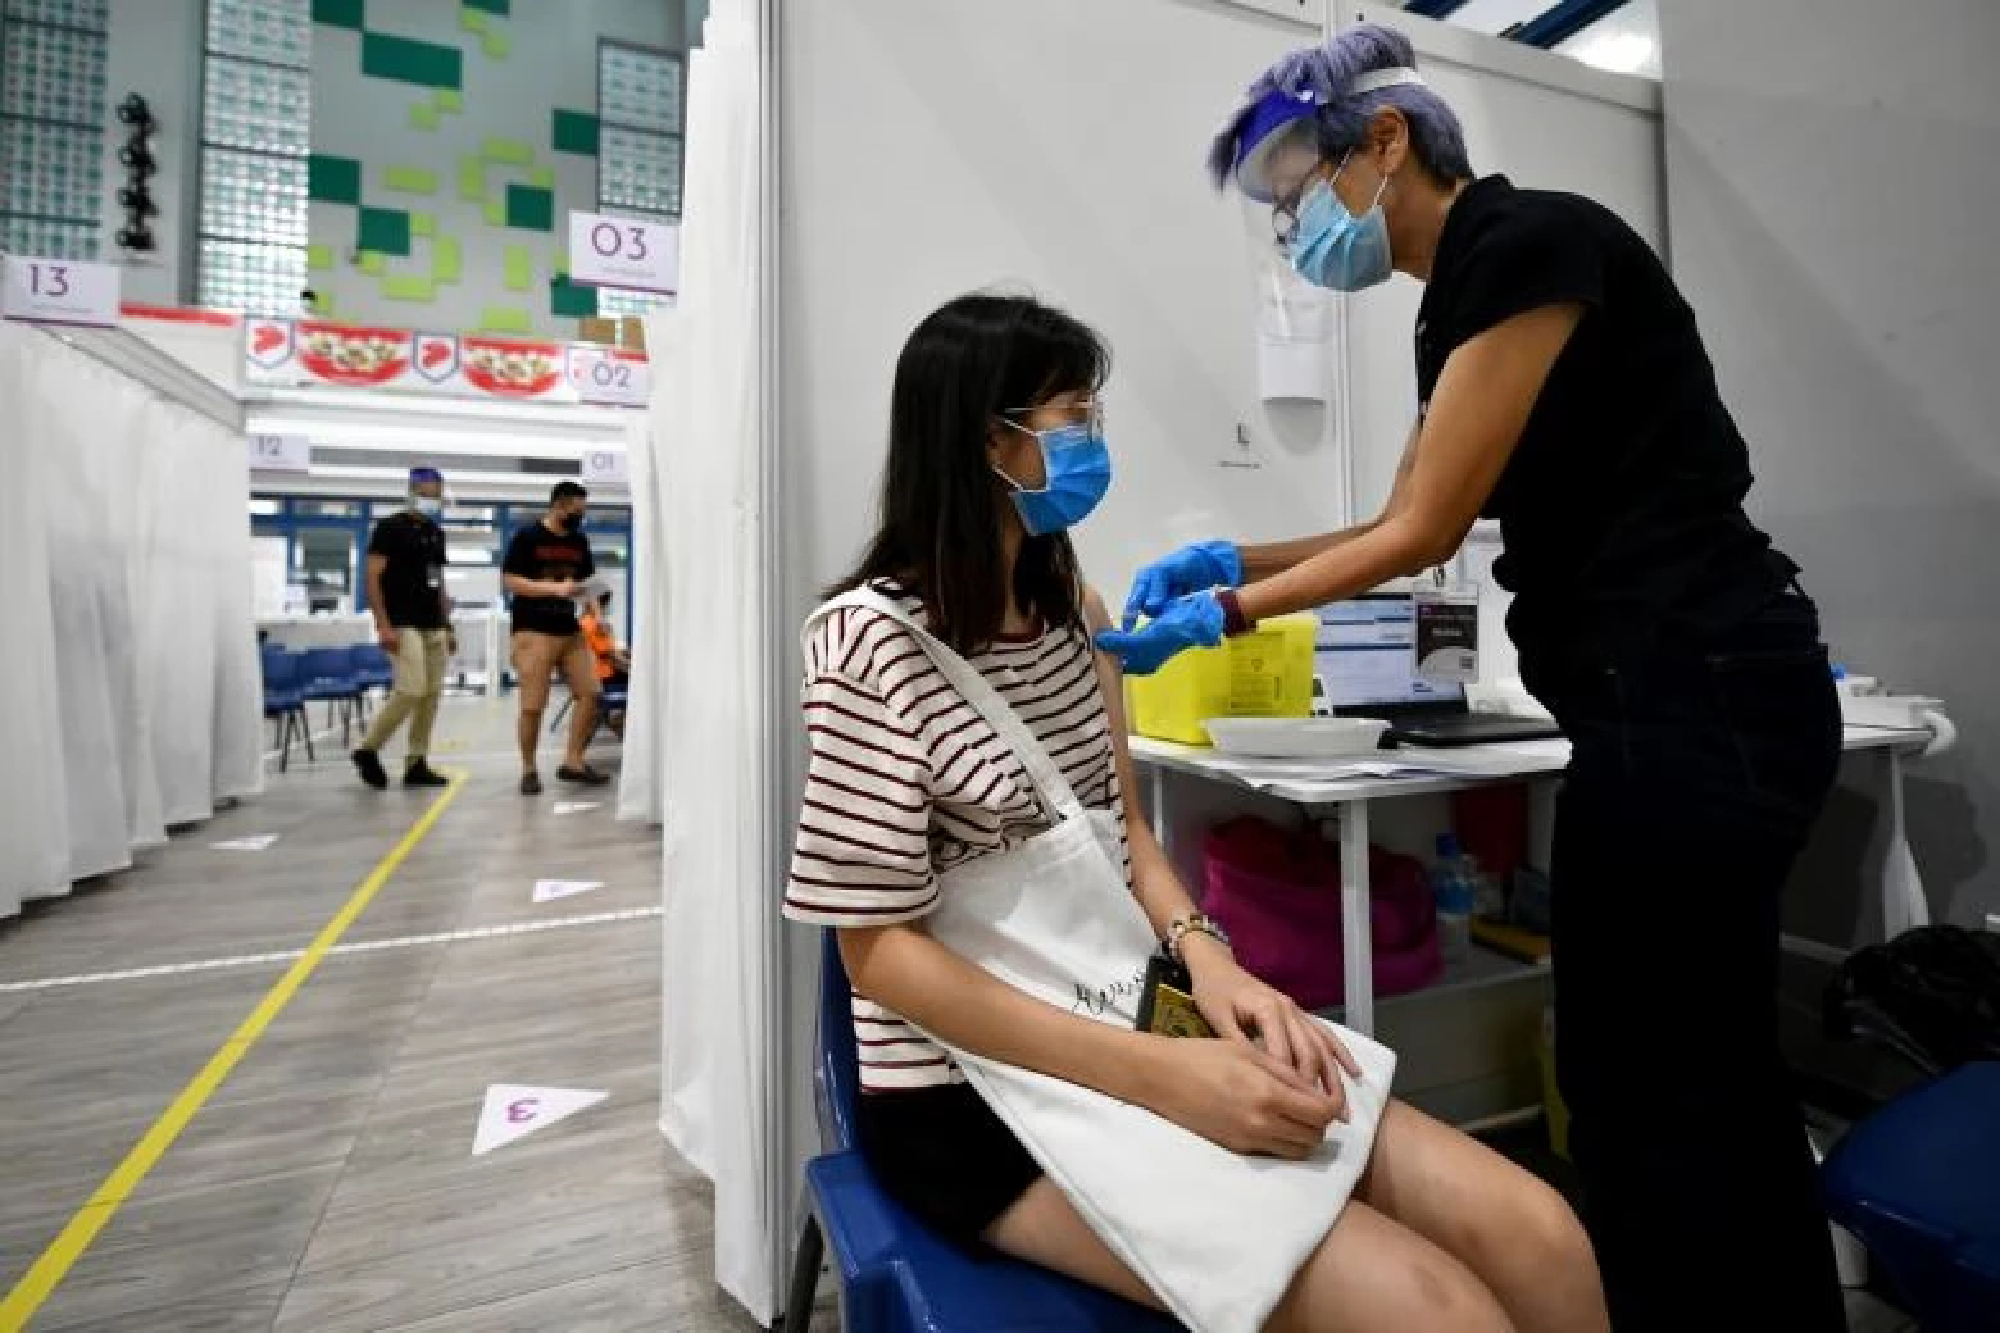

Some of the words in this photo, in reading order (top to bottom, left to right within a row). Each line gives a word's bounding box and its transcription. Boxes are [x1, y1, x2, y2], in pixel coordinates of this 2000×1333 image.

[592, 223, 646, 260] 03
[29, 264, 68, 297] 13
[592, 361, 631, 388] 02
[257, 434, 283, 456] 12
[592, 451, 613, 470] 01
